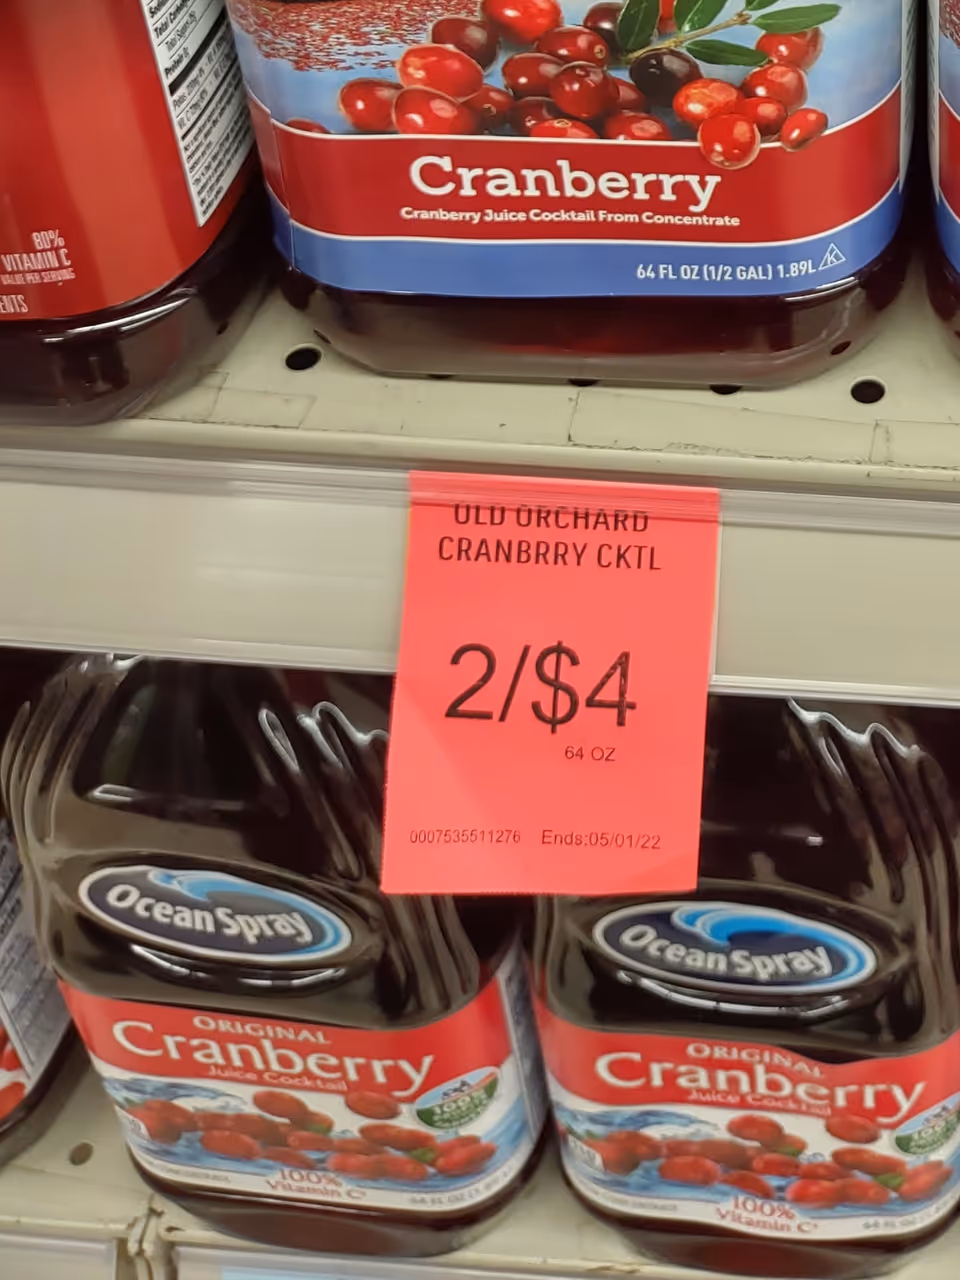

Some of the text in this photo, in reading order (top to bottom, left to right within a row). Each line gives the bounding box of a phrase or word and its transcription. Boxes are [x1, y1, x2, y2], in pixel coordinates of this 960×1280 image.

[410, 156, 721, 212] Cranberry
[400, 207, 741, 227] Cranberry Juice Cocktail From Concentrate
[1, 248, 71, 272] VITAMIN C
[636, 259, 817, 282] 64 FL OZ (1/2 GAL) 1.89L
[453, 503, 649, 532] OLD ORCHARD
[438, 536, 662, 570] CRANBRRY CKTL
[445, 640, 637, 735] 2/$4
[564, 745, 616, 762] 64 OZ
[409, 829, 661, 850] 0007535511276 Ends:05/01/22
[105, 882, 314, 945] Ocean Spray
[620, 924, 833, 982] Ocean Spray
[192, 1015, 331, 1045] ORIGINAL
[112, 1020, 435, 1097] Cranberry
[686, 1043, 824, 1079] ORIGINAL
[208, 1065, 348, 1092] Juice Cocktail
[594, 1052, 927, 1130] Cranberry
[688, 1089, 832, 1116] Juice Cocktail
[266, 1180, 342, 1199] Vitamin
[279, 1169, 343, 1189] 100%
[716, 1206, 792, 1233] Vitamin
[732, 1195, 795, 1221] 100%
